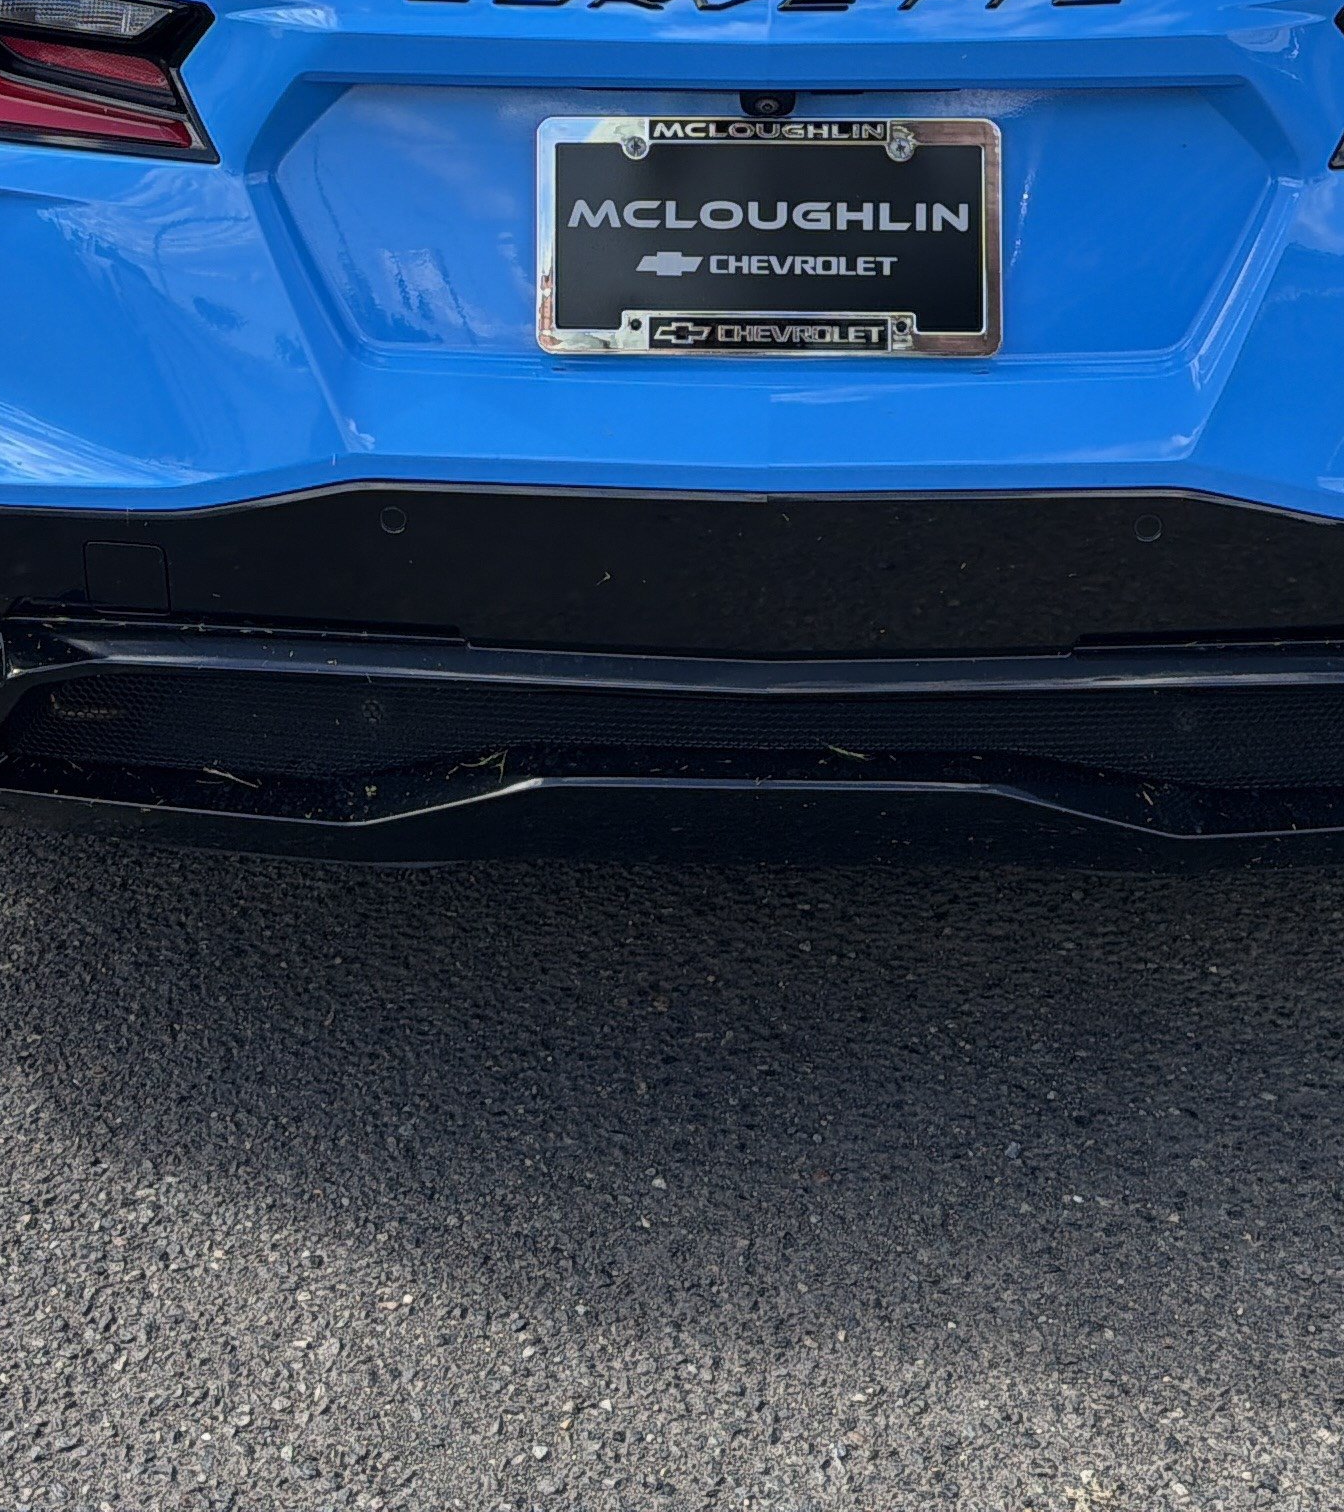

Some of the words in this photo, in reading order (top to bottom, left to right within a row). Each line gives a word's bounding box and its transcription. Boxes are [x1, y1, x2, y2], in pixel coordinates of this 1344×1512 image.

[653, 121, 885, 139] MCLOUGHLIN
[567, 199, 969, 232] MCLOUGHLIN
[709, 255, 898, 276] CHEVROLET
[717, 325, 884, 343] CHEVROLET
